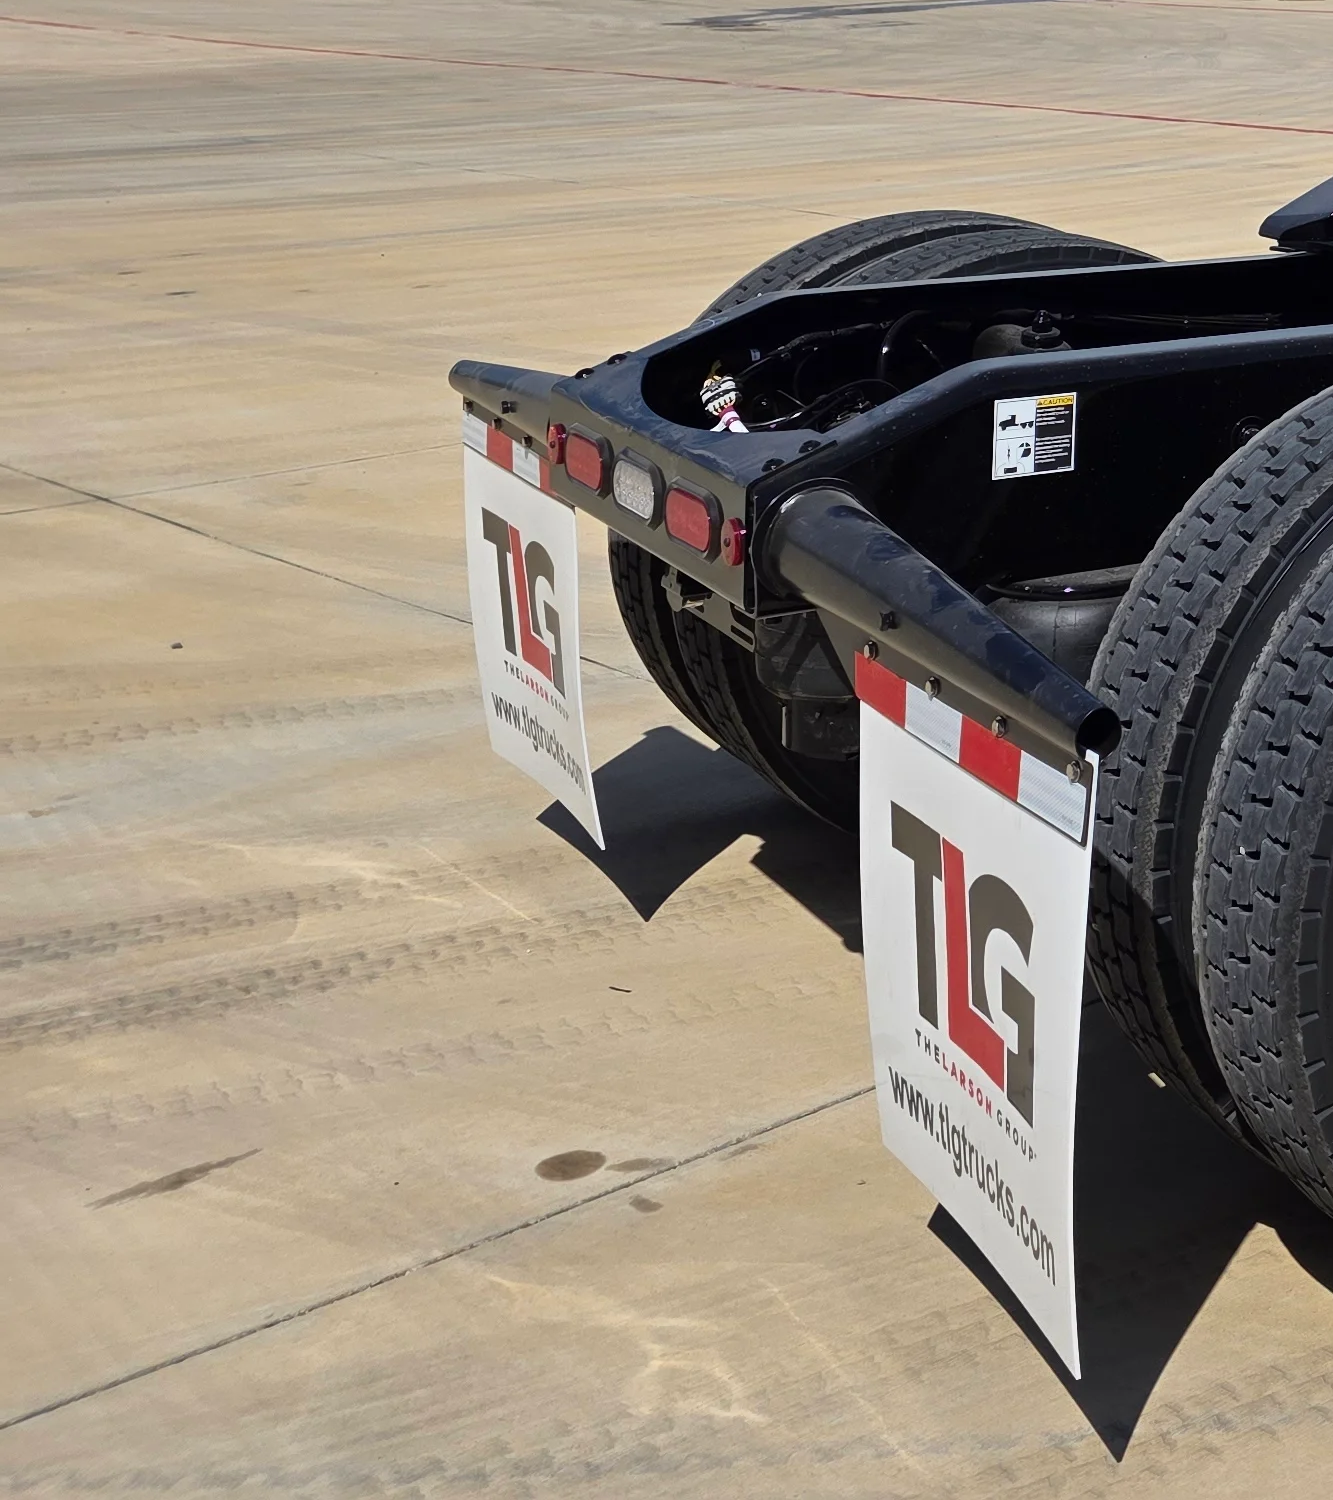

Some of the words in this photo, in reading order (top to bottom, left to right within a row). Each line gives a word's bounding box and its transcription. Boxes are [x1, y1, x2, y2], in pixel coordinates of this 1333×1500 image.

[1043, 397, 1073, 405] CAUTION
[481, 506, 566, 700] TLG
[491, 691, 587, 796] www.tlgtrucks.com
[890, 800, 1035, 1128] TLG
[888, 1065, 1056, 1287] www.tlgtrucks.com
